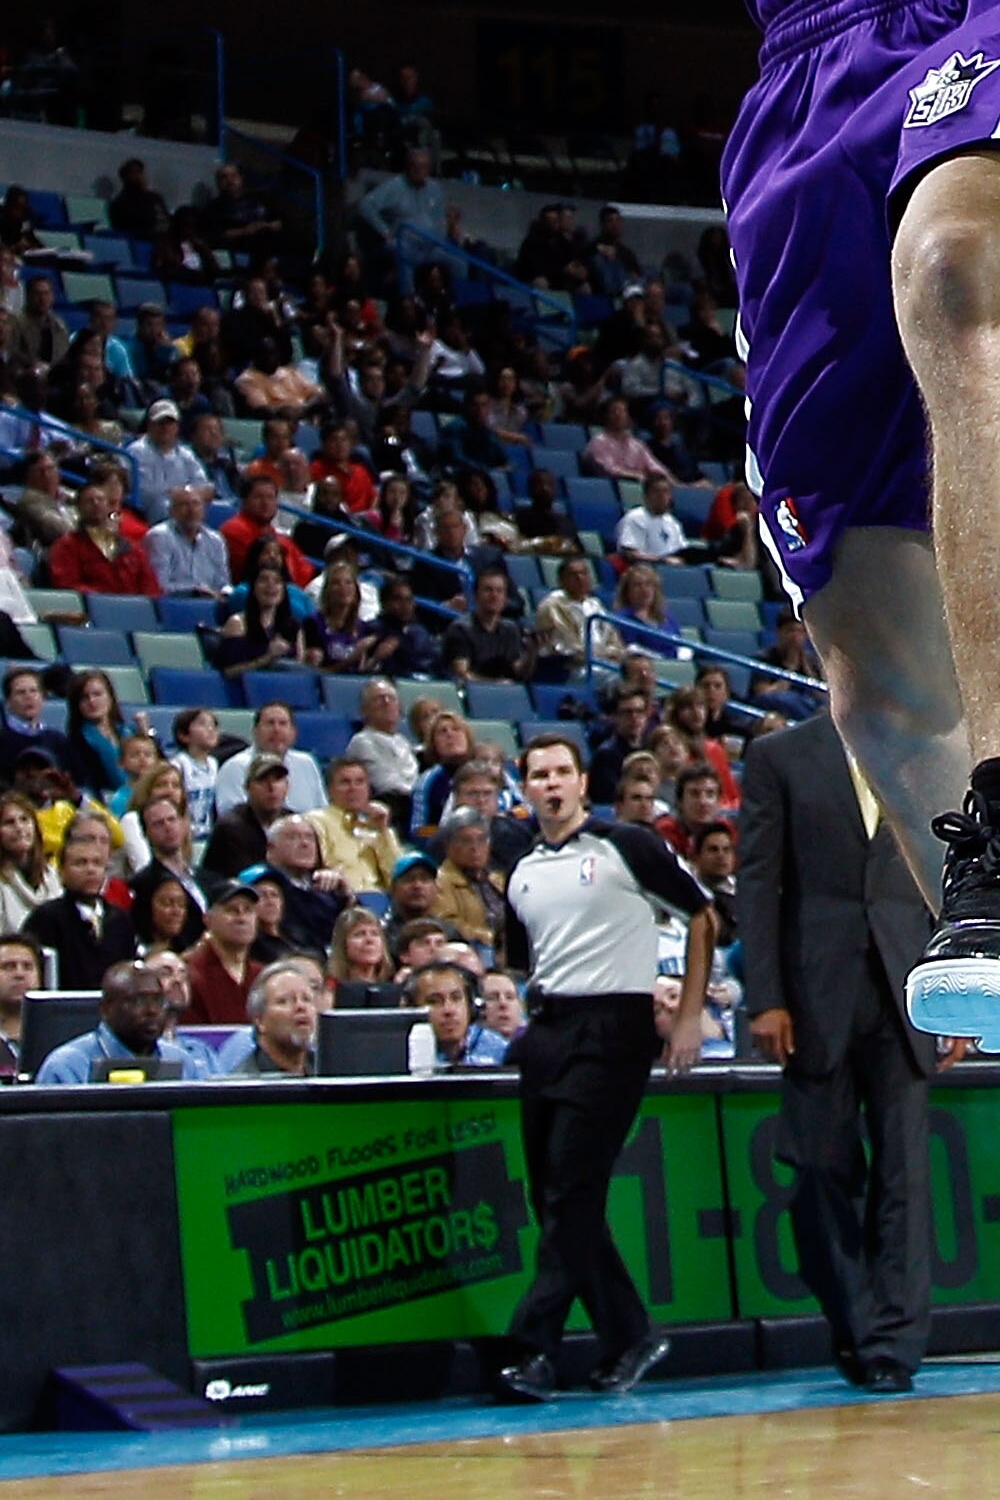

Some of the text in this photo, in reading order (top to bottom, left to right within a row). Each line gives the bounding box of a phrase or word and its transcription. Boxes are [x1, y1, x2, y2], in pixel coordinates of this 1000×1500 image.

[227, 1155, 320, 1195] HARDWOOD
[326, 1133, 397, 1168] FLOORS
[404, 1125, 441, 1149] FOR
[300, 1166, 452, 1240] LUMBER
